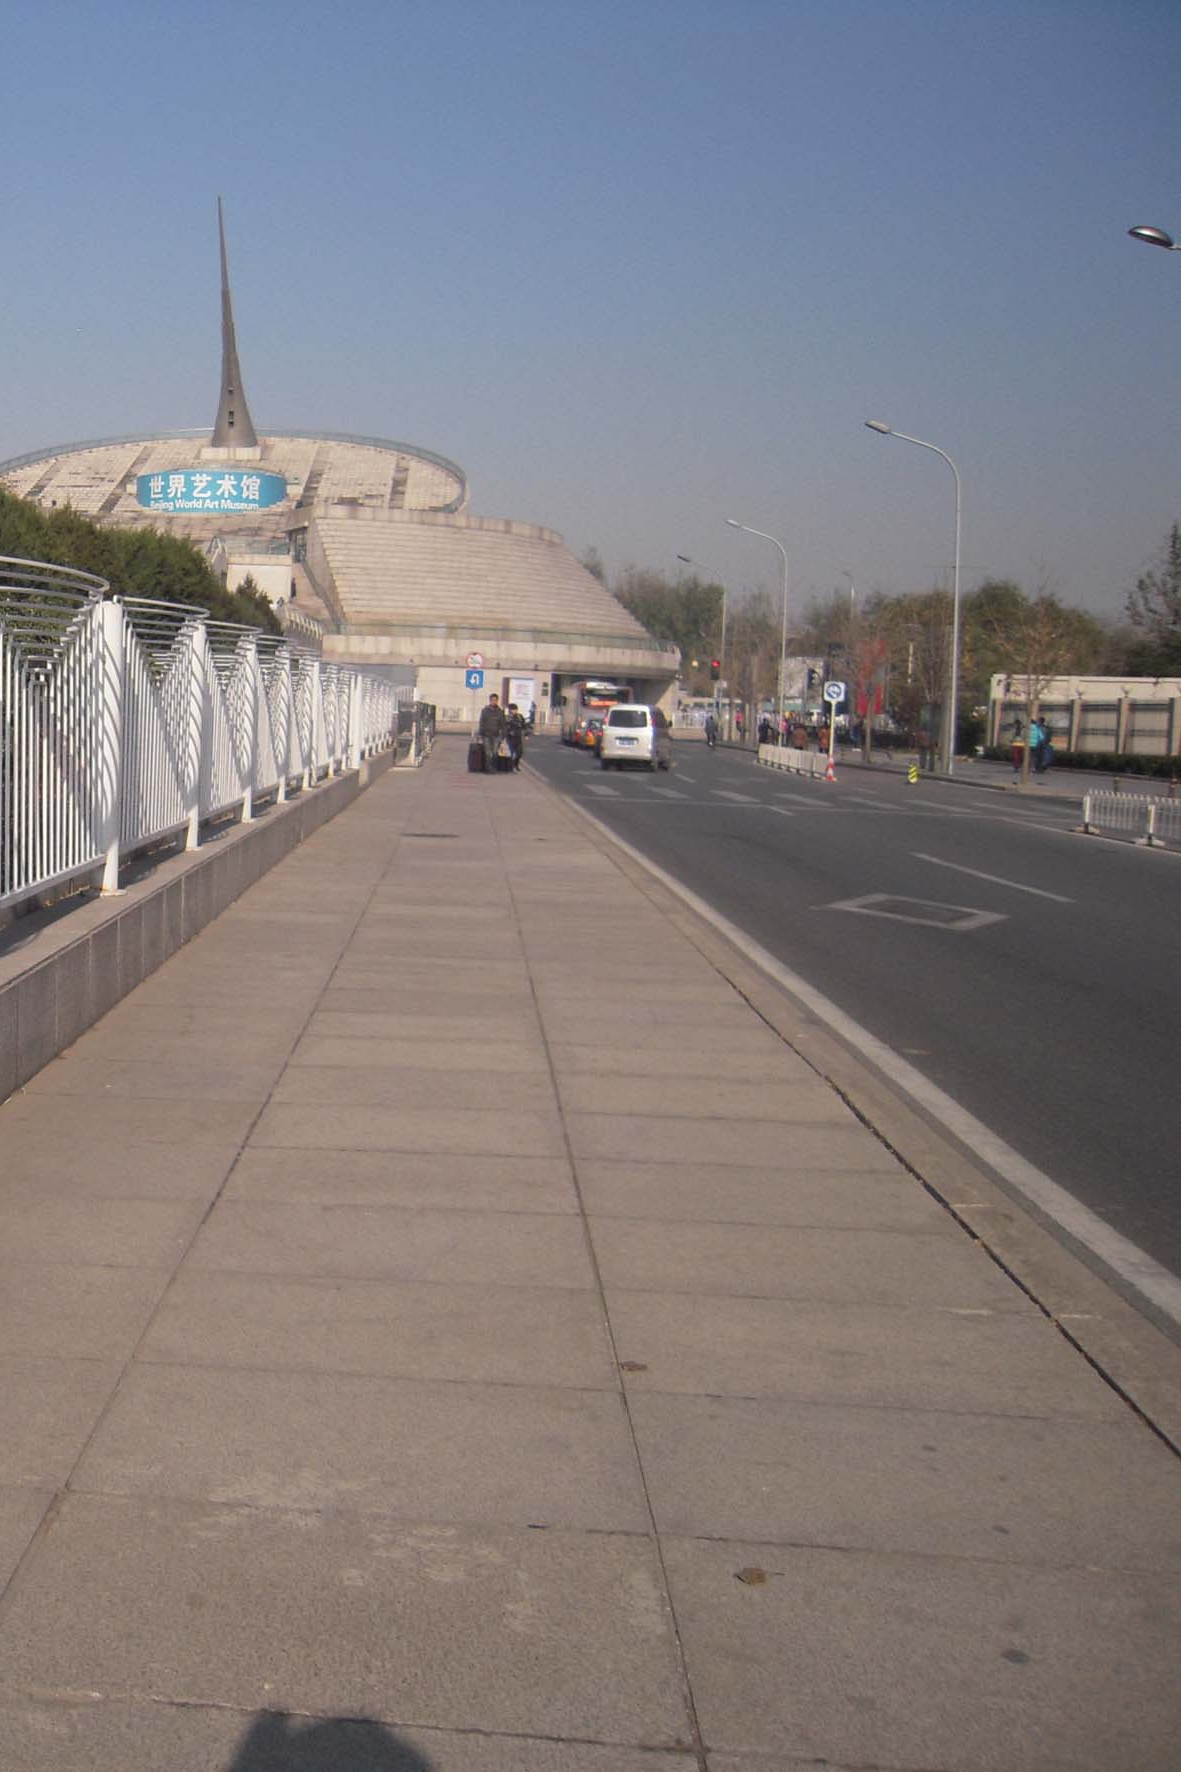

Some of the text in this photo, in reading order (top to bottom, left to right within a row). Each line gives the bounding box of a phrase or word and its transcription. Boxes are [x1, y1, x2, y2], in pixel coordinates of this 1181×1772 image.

[149, 474, 260, 499] 世界艺术馆
[175, 499, 202, 509] World
[204, 499, 219, 509] Art
[220, 499, 259, 511] Museum
